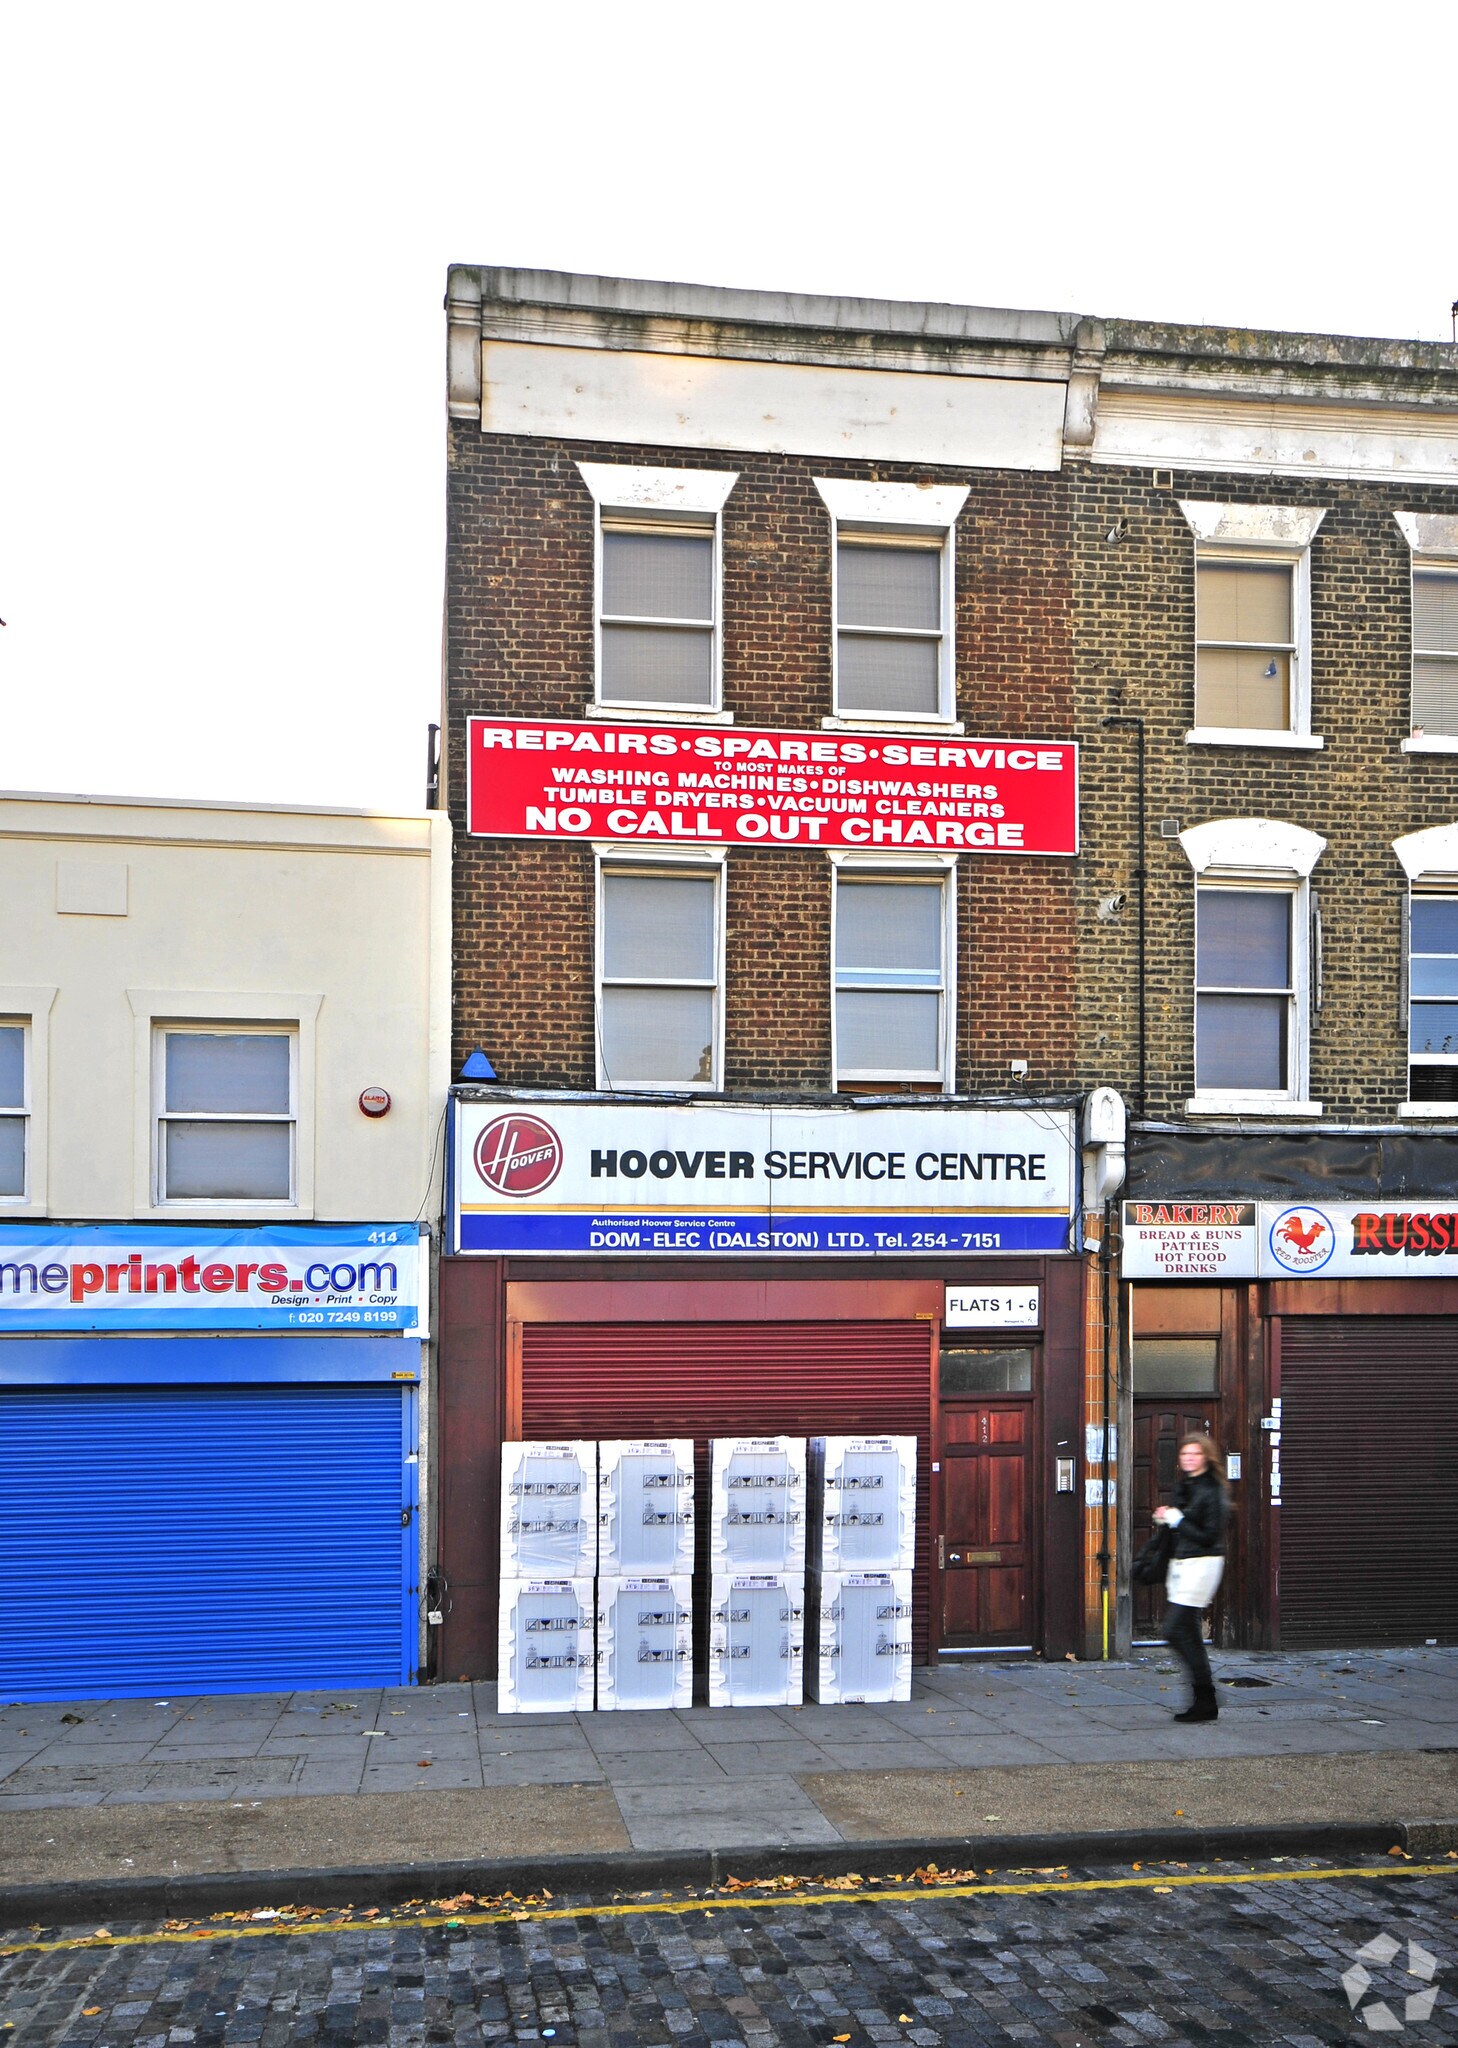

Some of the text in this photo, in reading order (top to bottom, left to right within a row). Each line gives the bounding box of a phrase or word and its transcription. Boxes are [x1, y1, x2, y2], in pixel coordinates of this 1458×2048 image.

[482, 727, 1064, 771] REPAIRS SPARES SERVICE
[714, 761, 847, 776] TO MOST MAKES OF
[551, 767, 998, 800] WASHING MACHINES DISHWASHERS
[543, 786, 1005, 818] TUMBLE DRYERS VACUUM CLEANERS
[525, 806, 1025, 847] NO CALL OUT CHARGE
[590, 1149, 1046, 1181] HOOVER SERVICE CENTRE
[1135, 1205, 1244, 1225] BAKERY
[591, 1218, 736, 1228] Authorised Hoover Service Centre
[367, 1231, 398, 1244] 414
[709, 1231, 819, 1249] (DALSTON)
[827, 1232, 870, 1248] LTD.
[874, 1232, 908, 1248] Tel.
[1139, 1230, 1242, 1240] BREAD & BUNS
[1161, 1241, 1220, 1251] PATTIES
[1154, 1253, 1227, 1262] HOT FOOD
[1274, 1246, 1330, 1265] RED ROOSTER
[1164, 1264, 1217, 1273] DRINKS
[271, 1295, 398, 1306] Design Print Copy
[949, 1299, 1000, 1311] FLATS
[1005, 1299, 1012, 1311] 1
[1028, 1299, 1037, 1311] 6
[298, 1313, 324, 1323] 020
[327, 1312, 360, 1323] 7249
[363, 1311, 397, 1323] 8199
